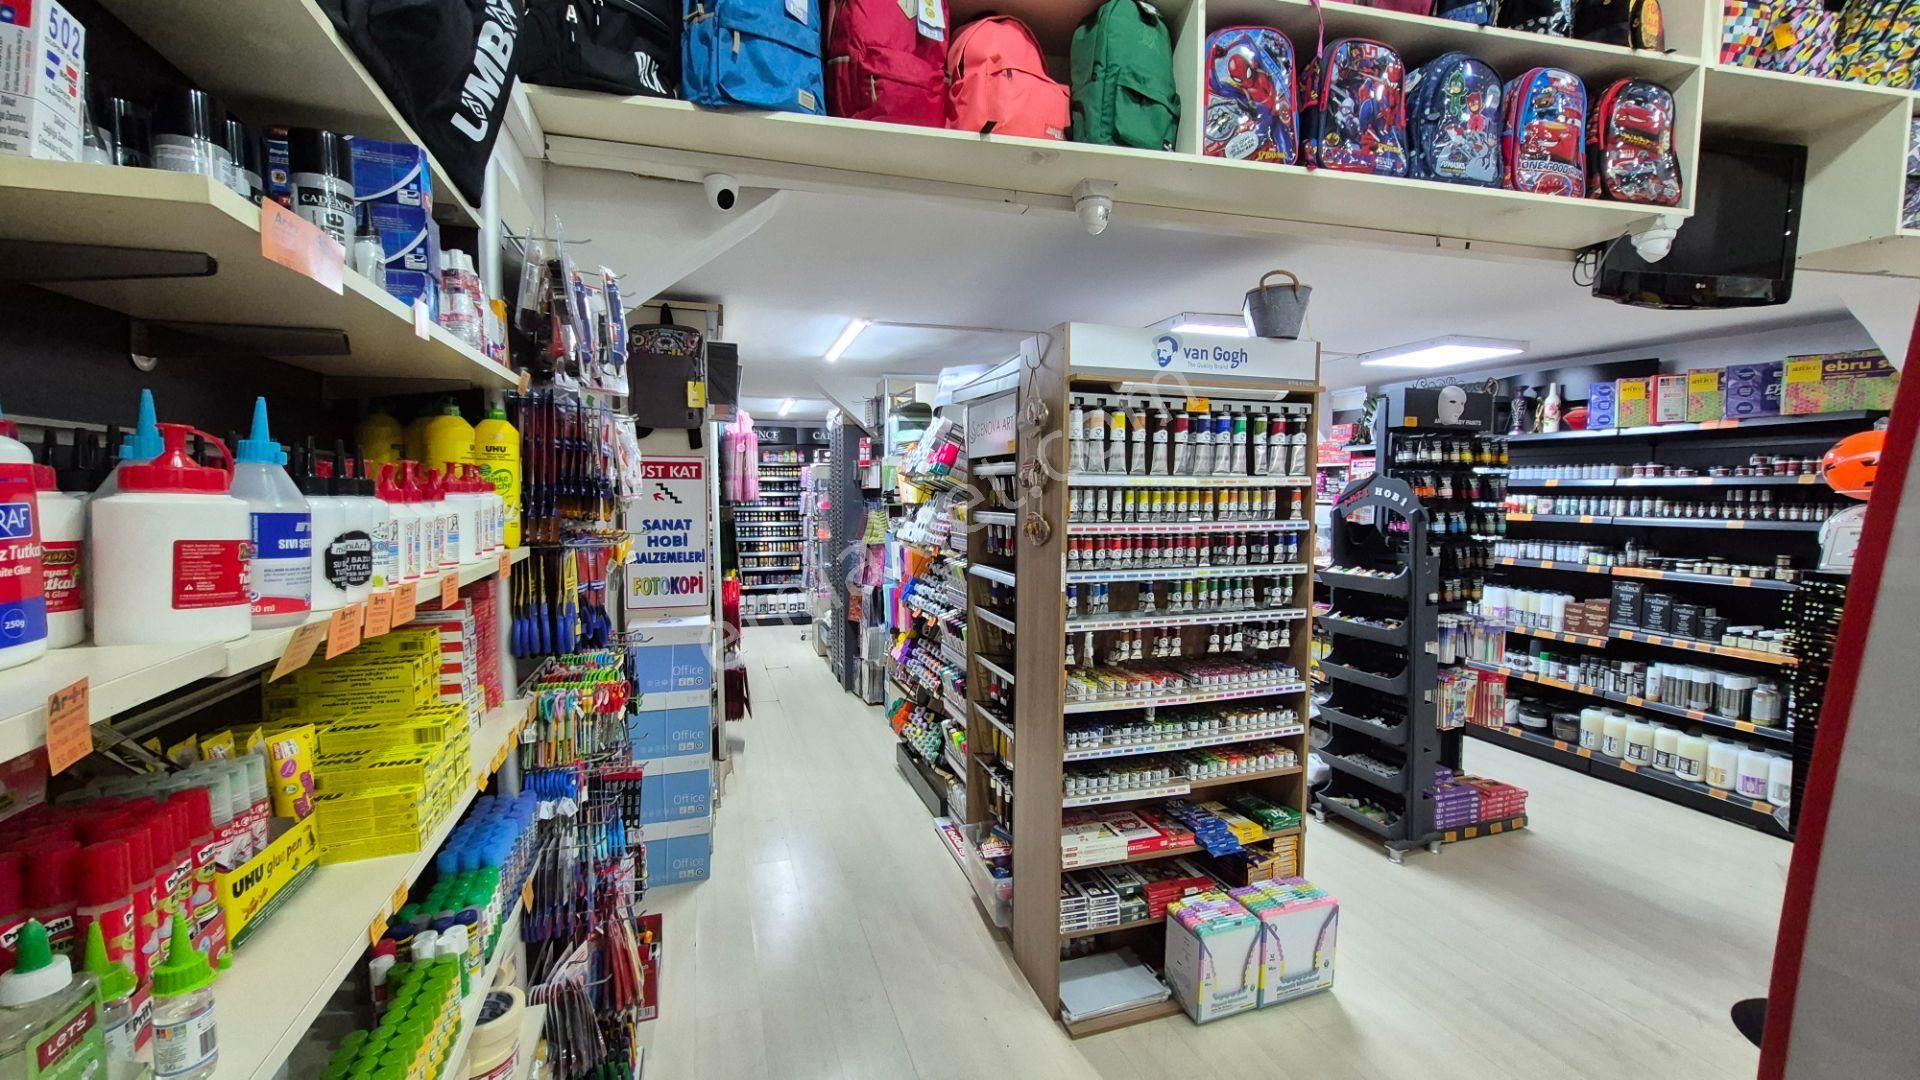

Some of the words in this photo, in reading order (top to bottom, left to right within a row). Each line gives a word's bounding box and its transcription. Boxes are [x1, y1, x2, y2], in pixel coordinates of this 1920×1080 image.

[49, 6, 81, 59] 502
[1521, 160, 1544, 169] ONE
[301, 193, 354, 213] CADENCE
[1183, 347, 1209, 361] van
[1213, 346, 1248, 369] Gogh
[1825, 359, 1871, 372] ebru
[485, 445, 507, 453] UHU
[670, 465, 698, 478] KAT
[1374, 487, 1408, 507] HOBI
[642, 519, 692, 531] SANAT
[278, 539, 297, 550] SIVI
[647, 533, 688, 547] HOBİ
[14, 565, 32, 576] Glue
[633, 571, 703, 596] FOTOKOPİ
[263, 604, 275, 612] ml
[5, 619, 25, 630] 250g
[672, 664, 704, 675] Office
[672, 729, 704, 742] Office
[673, 793, 705, 805] Office
[232, 863, 264, 898] UHU
[267, 851, 286, 879] glue
[286, 837, 302, 861] pen
[672, 857, 704, 870] Office
